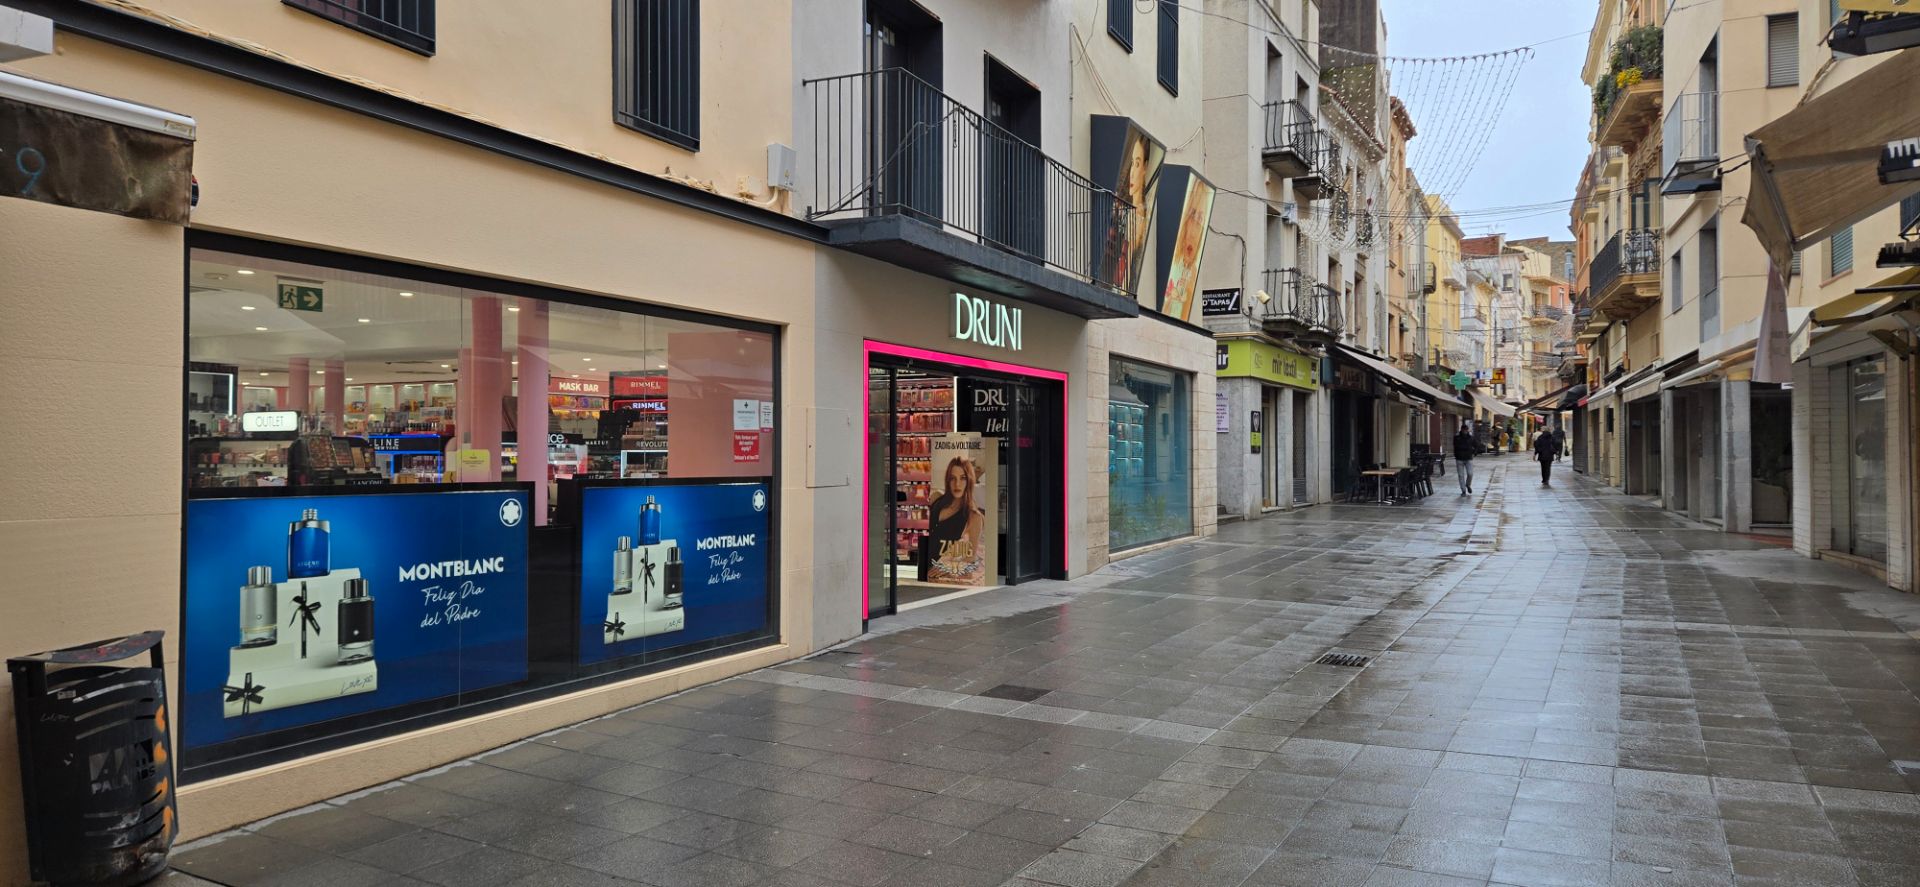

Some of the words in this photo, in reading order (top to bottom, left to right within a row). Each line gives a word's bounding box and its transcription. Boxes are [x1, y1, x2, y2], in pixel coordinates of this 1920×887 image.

[955, 292, 1022, 351] DRUNI
[559, 382, 581, 391] MASK
[583, 384, 599, 392] BAR
[632, 402, 666, 410] RIMMEL
[256, 415, 284, 427] OUTLET
[697, 533, 755, 550] MONTBLANC
[399, 556, 504, 582] MONTBLANC
[708, 553, 728, 569] Feliz
[707, 573, 720, 585] del
[721, 567, 741, 583] Padre
[421, 585, 457, 606] Feliz
[420, 611, 441, 628] del
[444, 603, 480, 624] Padre
